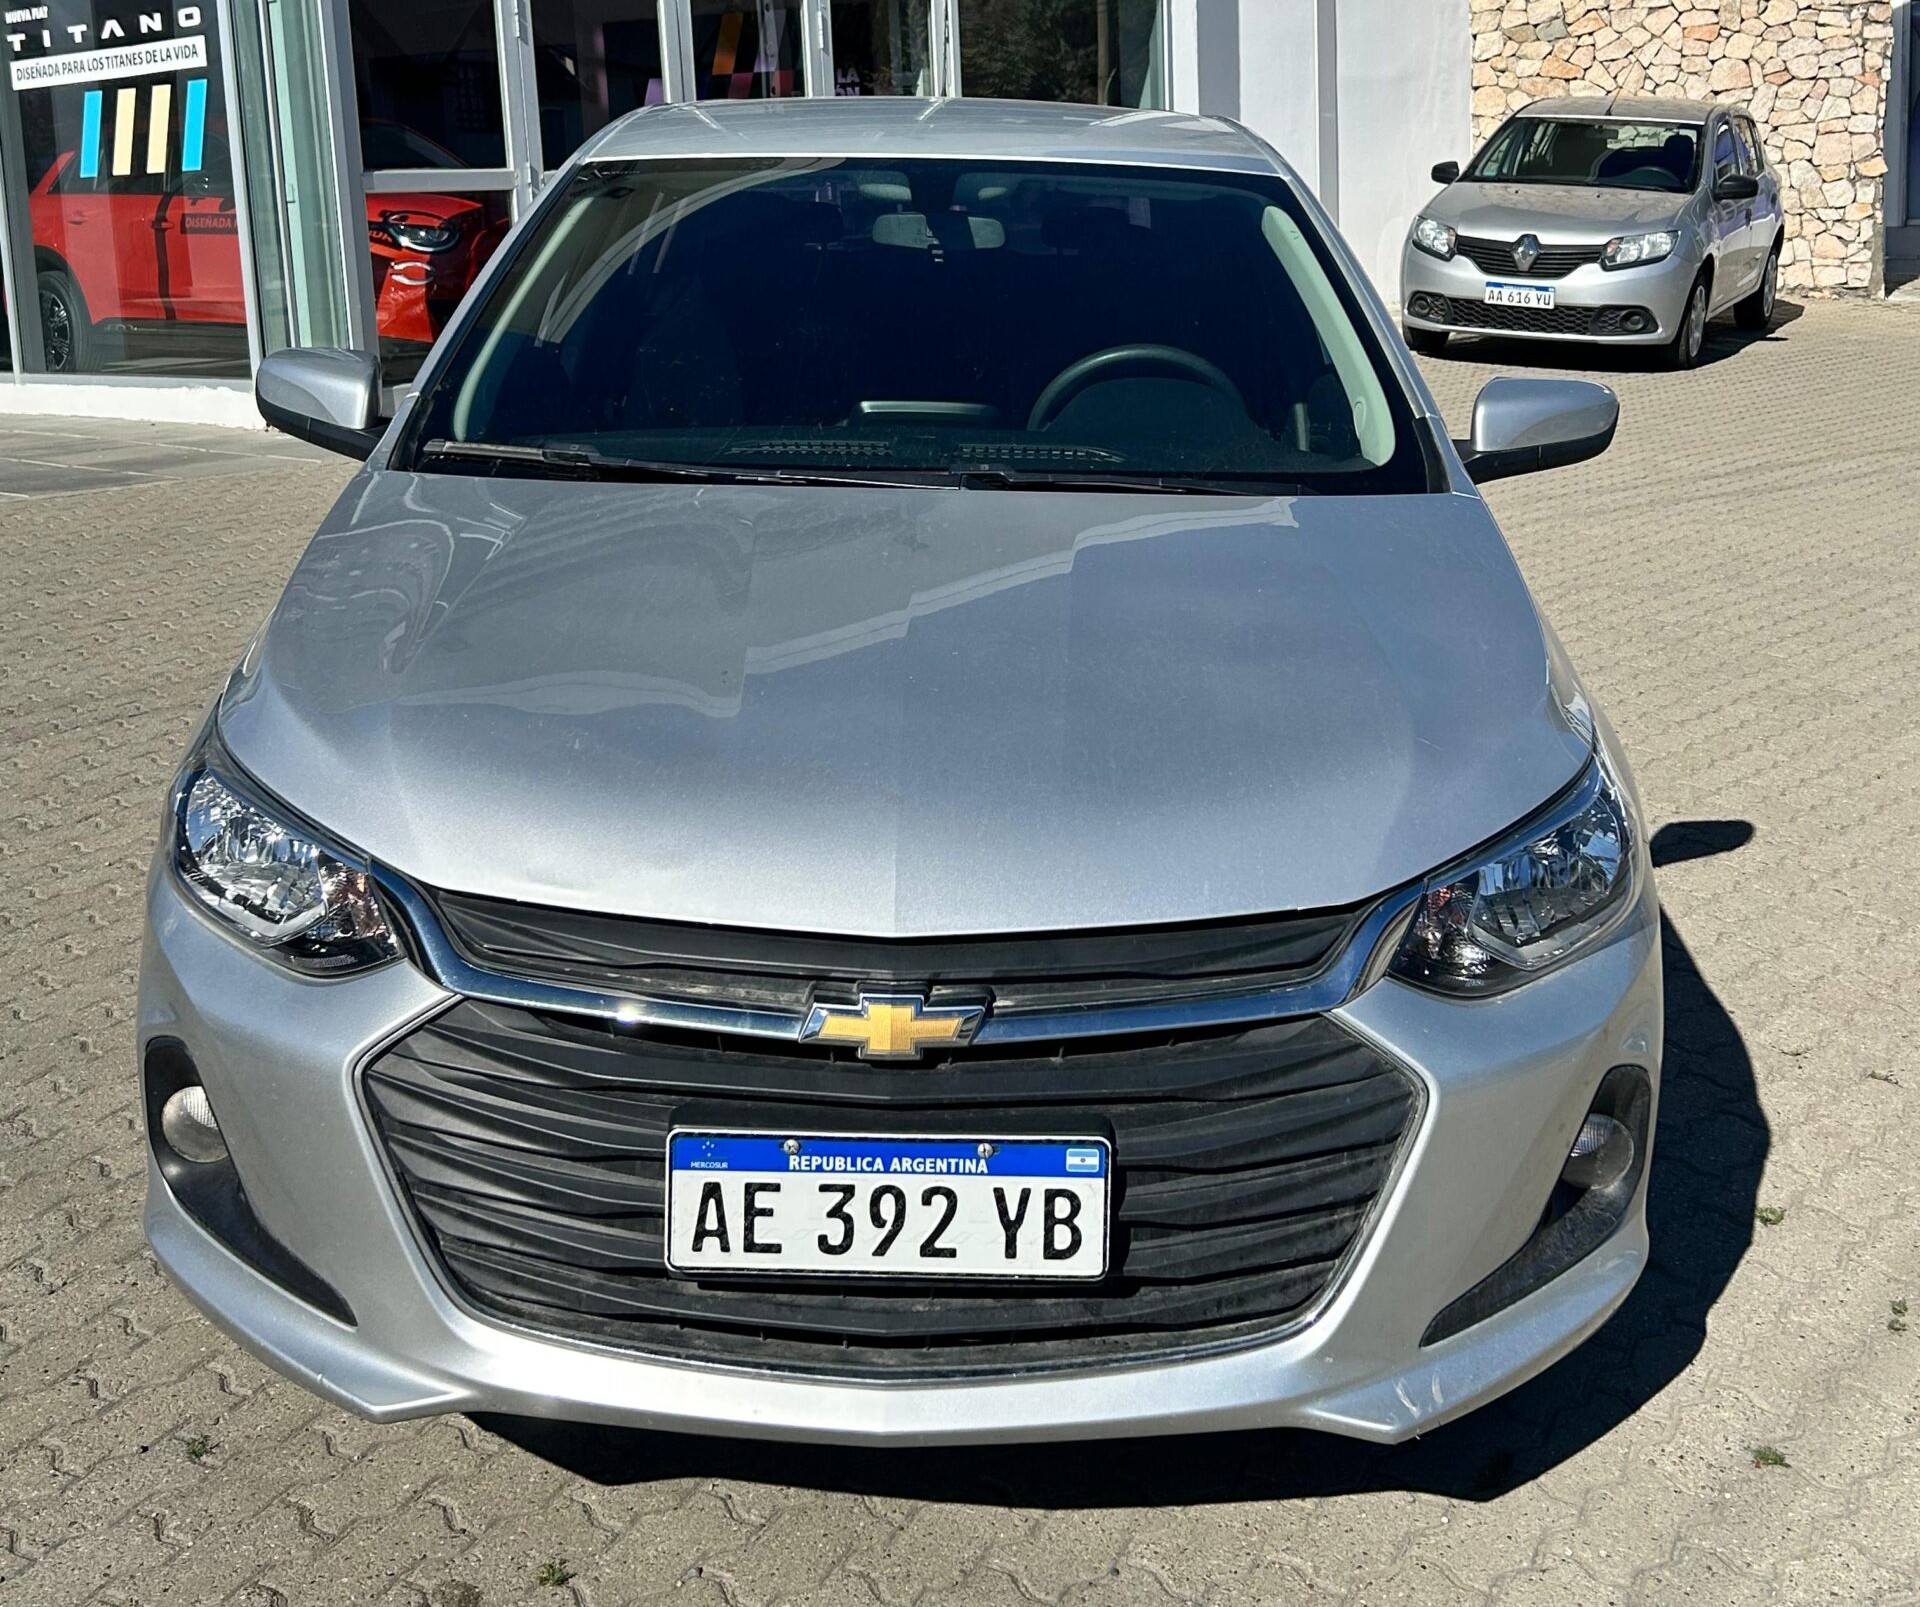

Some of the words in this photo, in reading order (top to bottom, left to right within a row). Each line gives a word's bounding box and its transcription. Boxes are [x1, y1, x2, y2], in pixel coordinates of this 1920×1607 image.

[5, 8, 32, 24] NUEVA
[31, 5, 48, 20] FIAT
[6, 6, 201, 51] TITANO
[16, 62, 61, 81] DISEÑADA
[62, 60, 86, 75] PARA
[87, 56, 105, 72] LOS
[105, 52, 143, 69] TITANES
[145, 49, 158, 64] DE
[160, 47, 172, 62] LA
[173, 44, 199, 60] VIDA
[185, 215, 232, 228] DISEÑADA
[1488, 290, 1502, 302] AA
[1508, 291, 1530, 304] 616
[1536, 293, 1551, 305] YU
[690, 1161, 728, 1169] MERCOSUR
[789, 1154, 884, 1172] REPUBLICA
[888, 1156, 988, 1174] ARGENTINA
[691, 1181, 782, 1254] AE
[817, 1183, 957, 1259] 392
[992, 1187, 1083, 1260] YB
